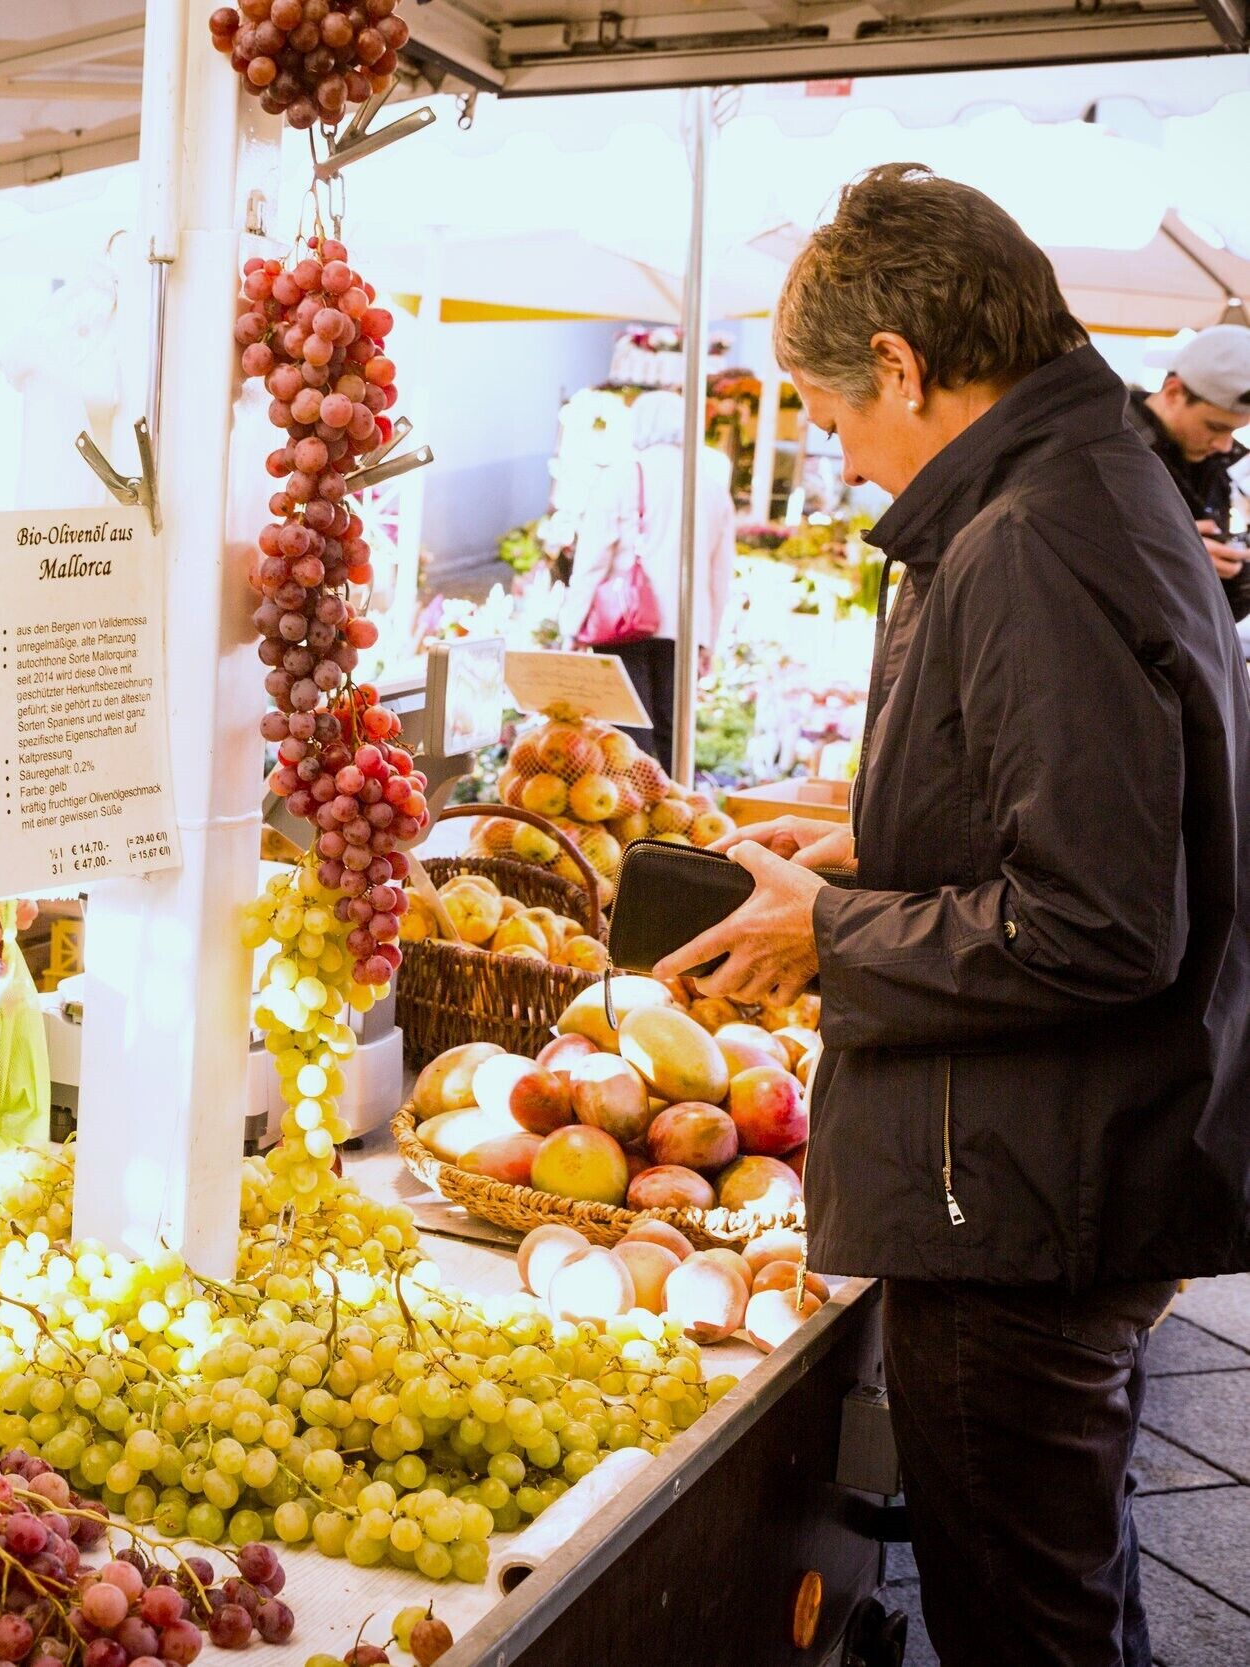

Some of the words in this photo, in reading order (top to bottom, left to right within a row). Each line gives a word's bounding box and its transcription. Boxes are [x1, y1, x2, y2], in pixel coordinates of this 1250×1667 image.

[17, 522, 109, 546] Bio-Olivenöl
[110, 527, 133, 542] aus
[39, 554, 112, 580] Mallorca
[17, 627, 31, 636] aus
[34, 623, 49, 634] den
[52, 620, 80, 634] Bergen
[82, 621, 96, 629] von
[99, 616, 147, 631] Valldemossa
[81, 636, 96, 646] alte
[98, 633, 136, 647] Pflanzung
[17, 656, 66, 669] autochthone
[69, 652, 90, 664] Sorte
[17, 674, 31, 685] seit
[34, 672, 53, 684] 2014
[56, 670, 72, 681] wird
[74, 667, 95, 679] diese
[98, 666, 118, 677] Olive
[121, 664, 132, 674] mit
[17, 686, 64, 703] geschützter
[66, 677, 152, 695] Herkunftsbezeichnung
[50, 702, 62, 712] sie
[65, 699, 90, 713] gehört
[93, 700, 102, 708] zu
[104, 694, 118, 706] den
[121, 692, 151, 704] ältesten
[18, 720, 45, 732] Sorten
[47, 717, 84, 730] Spaniens
[86, 714, 103, 723] und
[104, 711, 124, 721] weist
[126, 708, 146, 721] ganz
[18, 732, 63, 747] spezifische
[66, 726, 122, 743] Eigenschaften
[125, 723, 137, 734] auf
[19, 748, 72, 765] Kaltpressung
[19, 764, 72, 782] Säuregehalt:
[74, 762, 95, 774] 0,2%
[20, 786, 47, 797] Farbe:
[50, 782, 67, 795] gelb
[21, 801, 46, 814] kräftig
[49, 794, 87, 810] fruchtiger
[89, 783, 162, 802] Olivenölgeschmack
[22, 820, 35, 830] mit
[37, 816, 57, 827] einer
[59, 811, 98, 826] gewissen
[101, 805, 122, 817] Süße
[72, 845, 76, 855] €
[135, 834, 154, 844] 29,40
[53, 865, 57, 874] 3
[74, 860, 79, 870] €
[139, 848, 157, 859] 15,67
